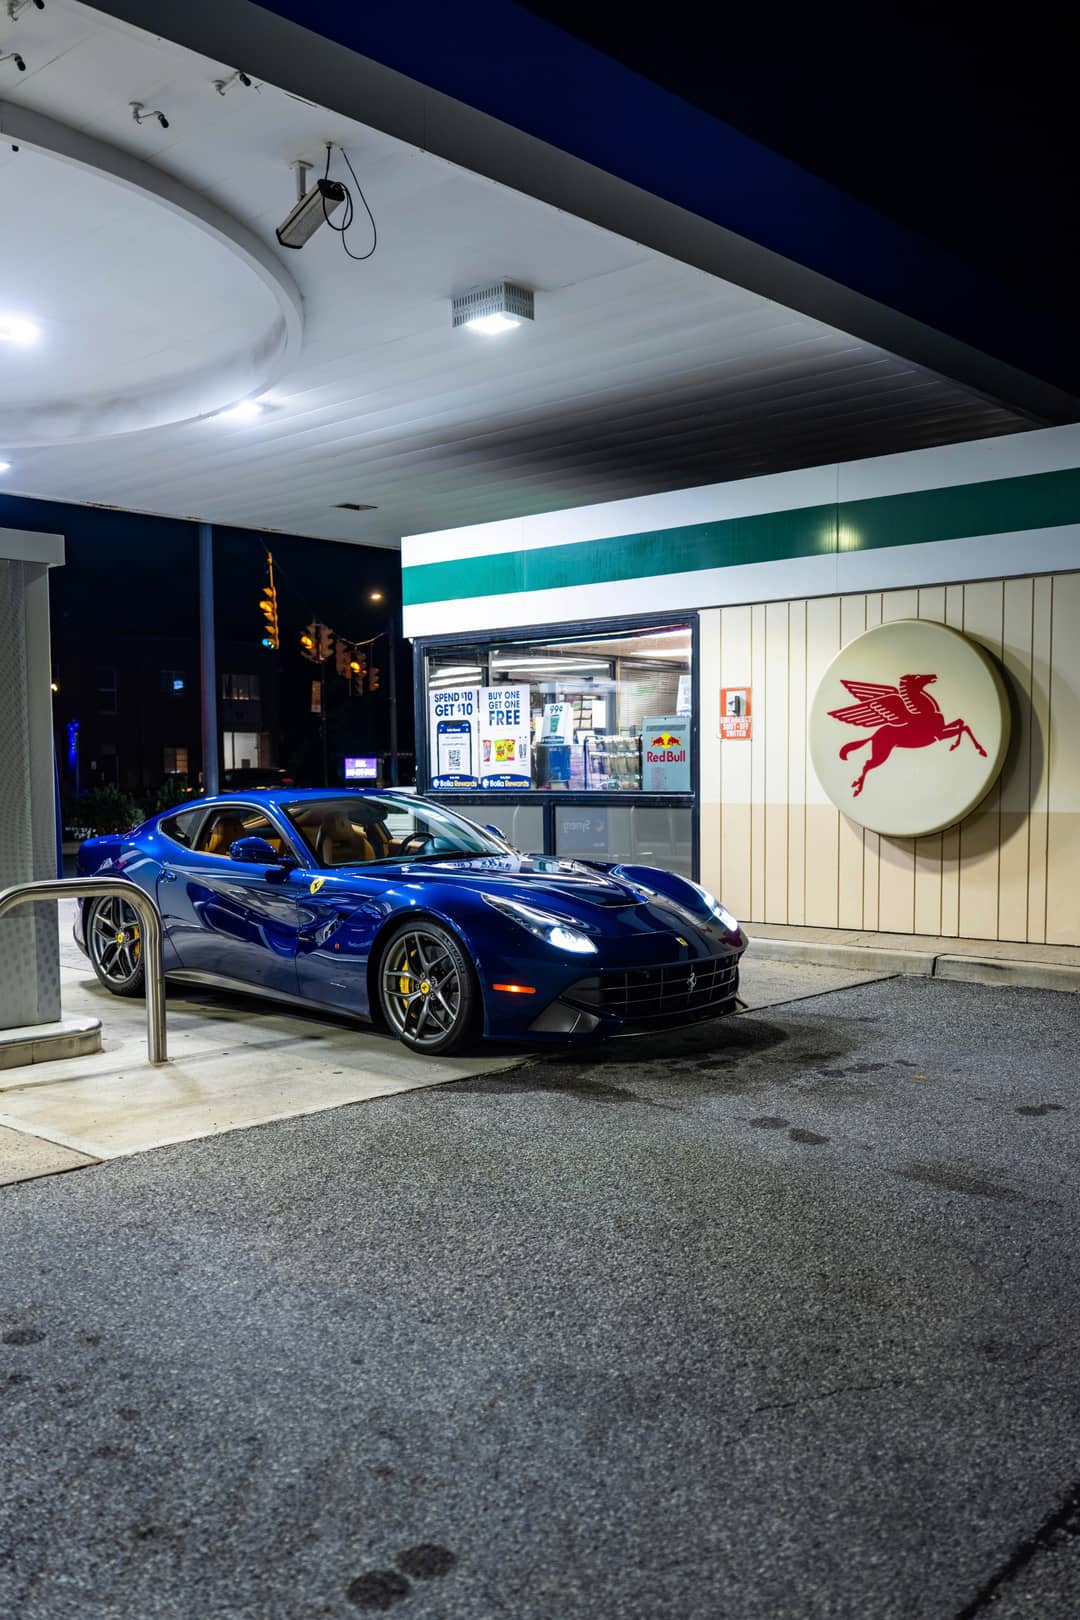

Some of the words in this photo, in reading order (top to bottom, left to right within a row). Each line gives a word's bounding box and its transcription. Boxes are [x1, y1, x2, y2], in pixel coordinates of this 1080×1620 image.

[434, 692, 460, 703] SPEND
[461, 691, 473, 702] $10
[488, 692, 502, 700] BUY
[504, 690, 520, 700] ONE
[435, 704, 454, 717] GET
[458, 703, 473, 716] $10
[488, 701, 502, 710] GET
[504, 700, 520, 709] ONE
[489, 709, 520, 726] FREE
[646, 750, 666, 763] Red
[667, 749, 686, 762] Bull
